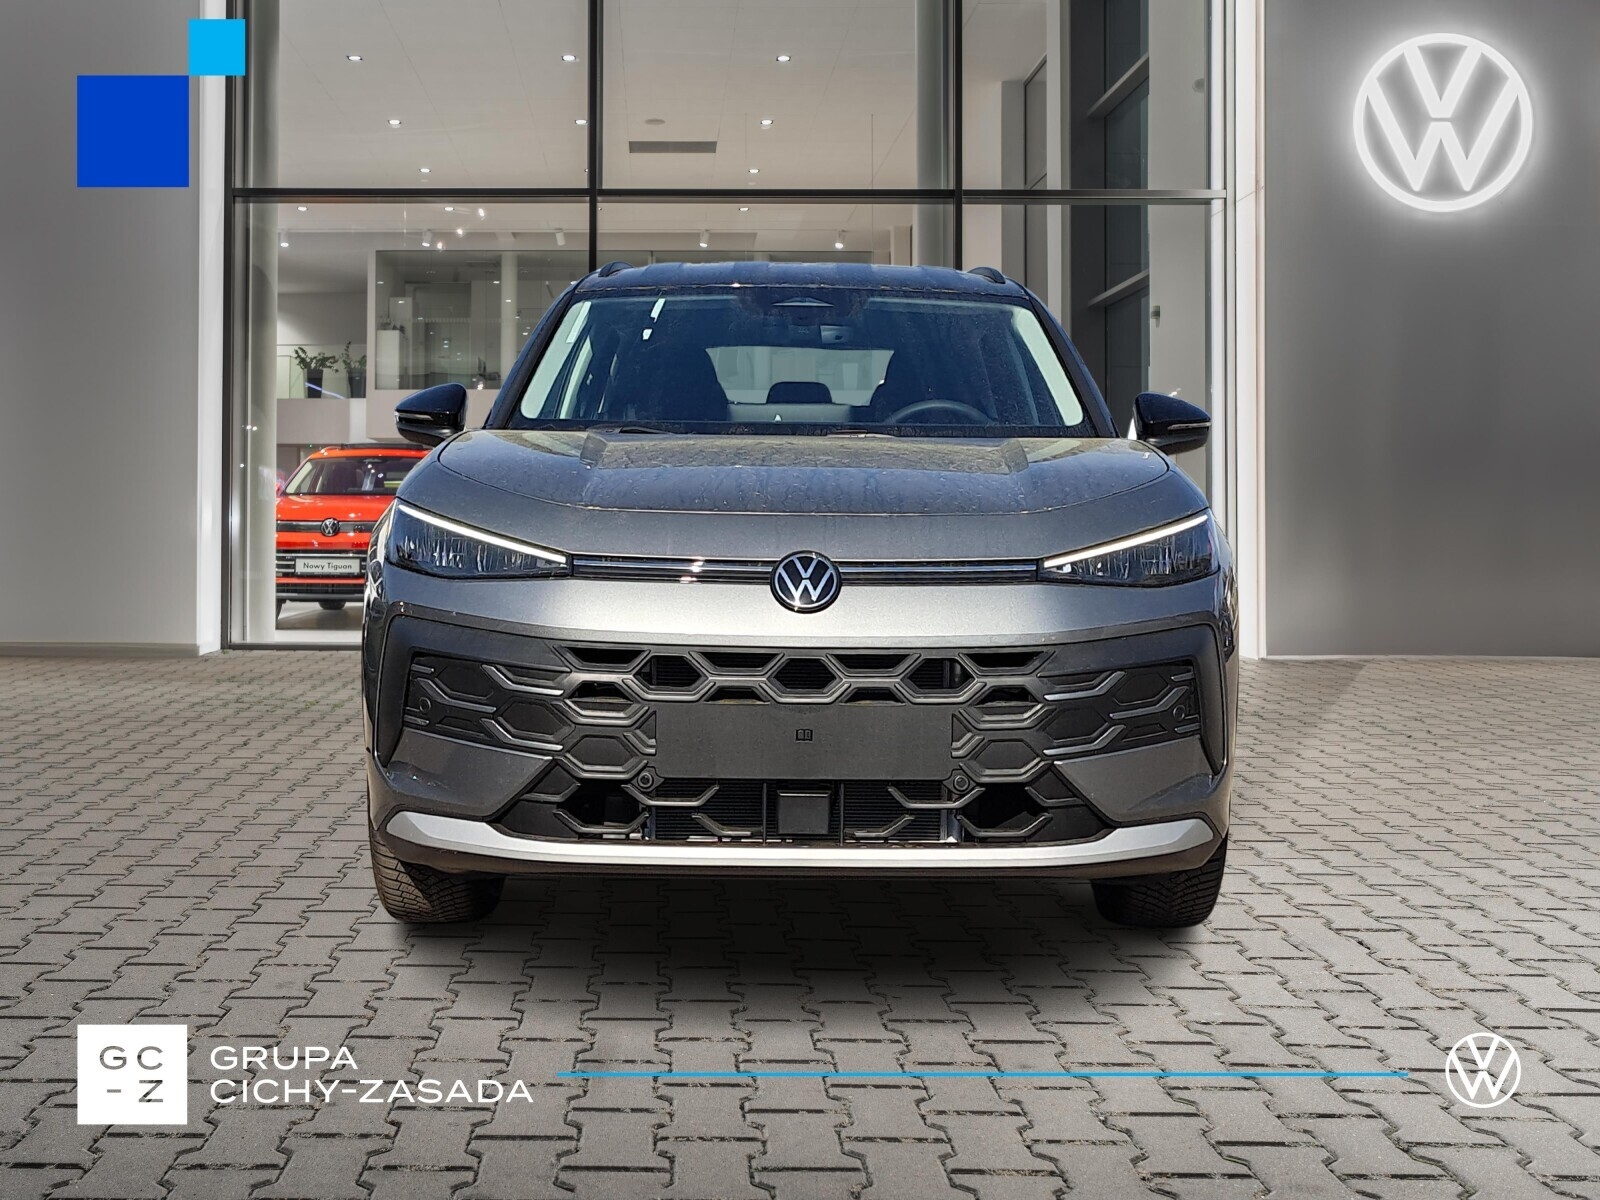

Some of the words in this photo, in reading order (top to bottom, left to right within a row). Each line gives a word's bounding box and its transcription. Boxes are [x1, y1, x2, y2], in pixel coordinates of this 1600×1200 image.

[1358, 36, 1528, 202] VW
[303, 562, 325, 570] Nowy
[327, 562, 352, 571] Tiguan
[775, 554, 838, 606] VW
